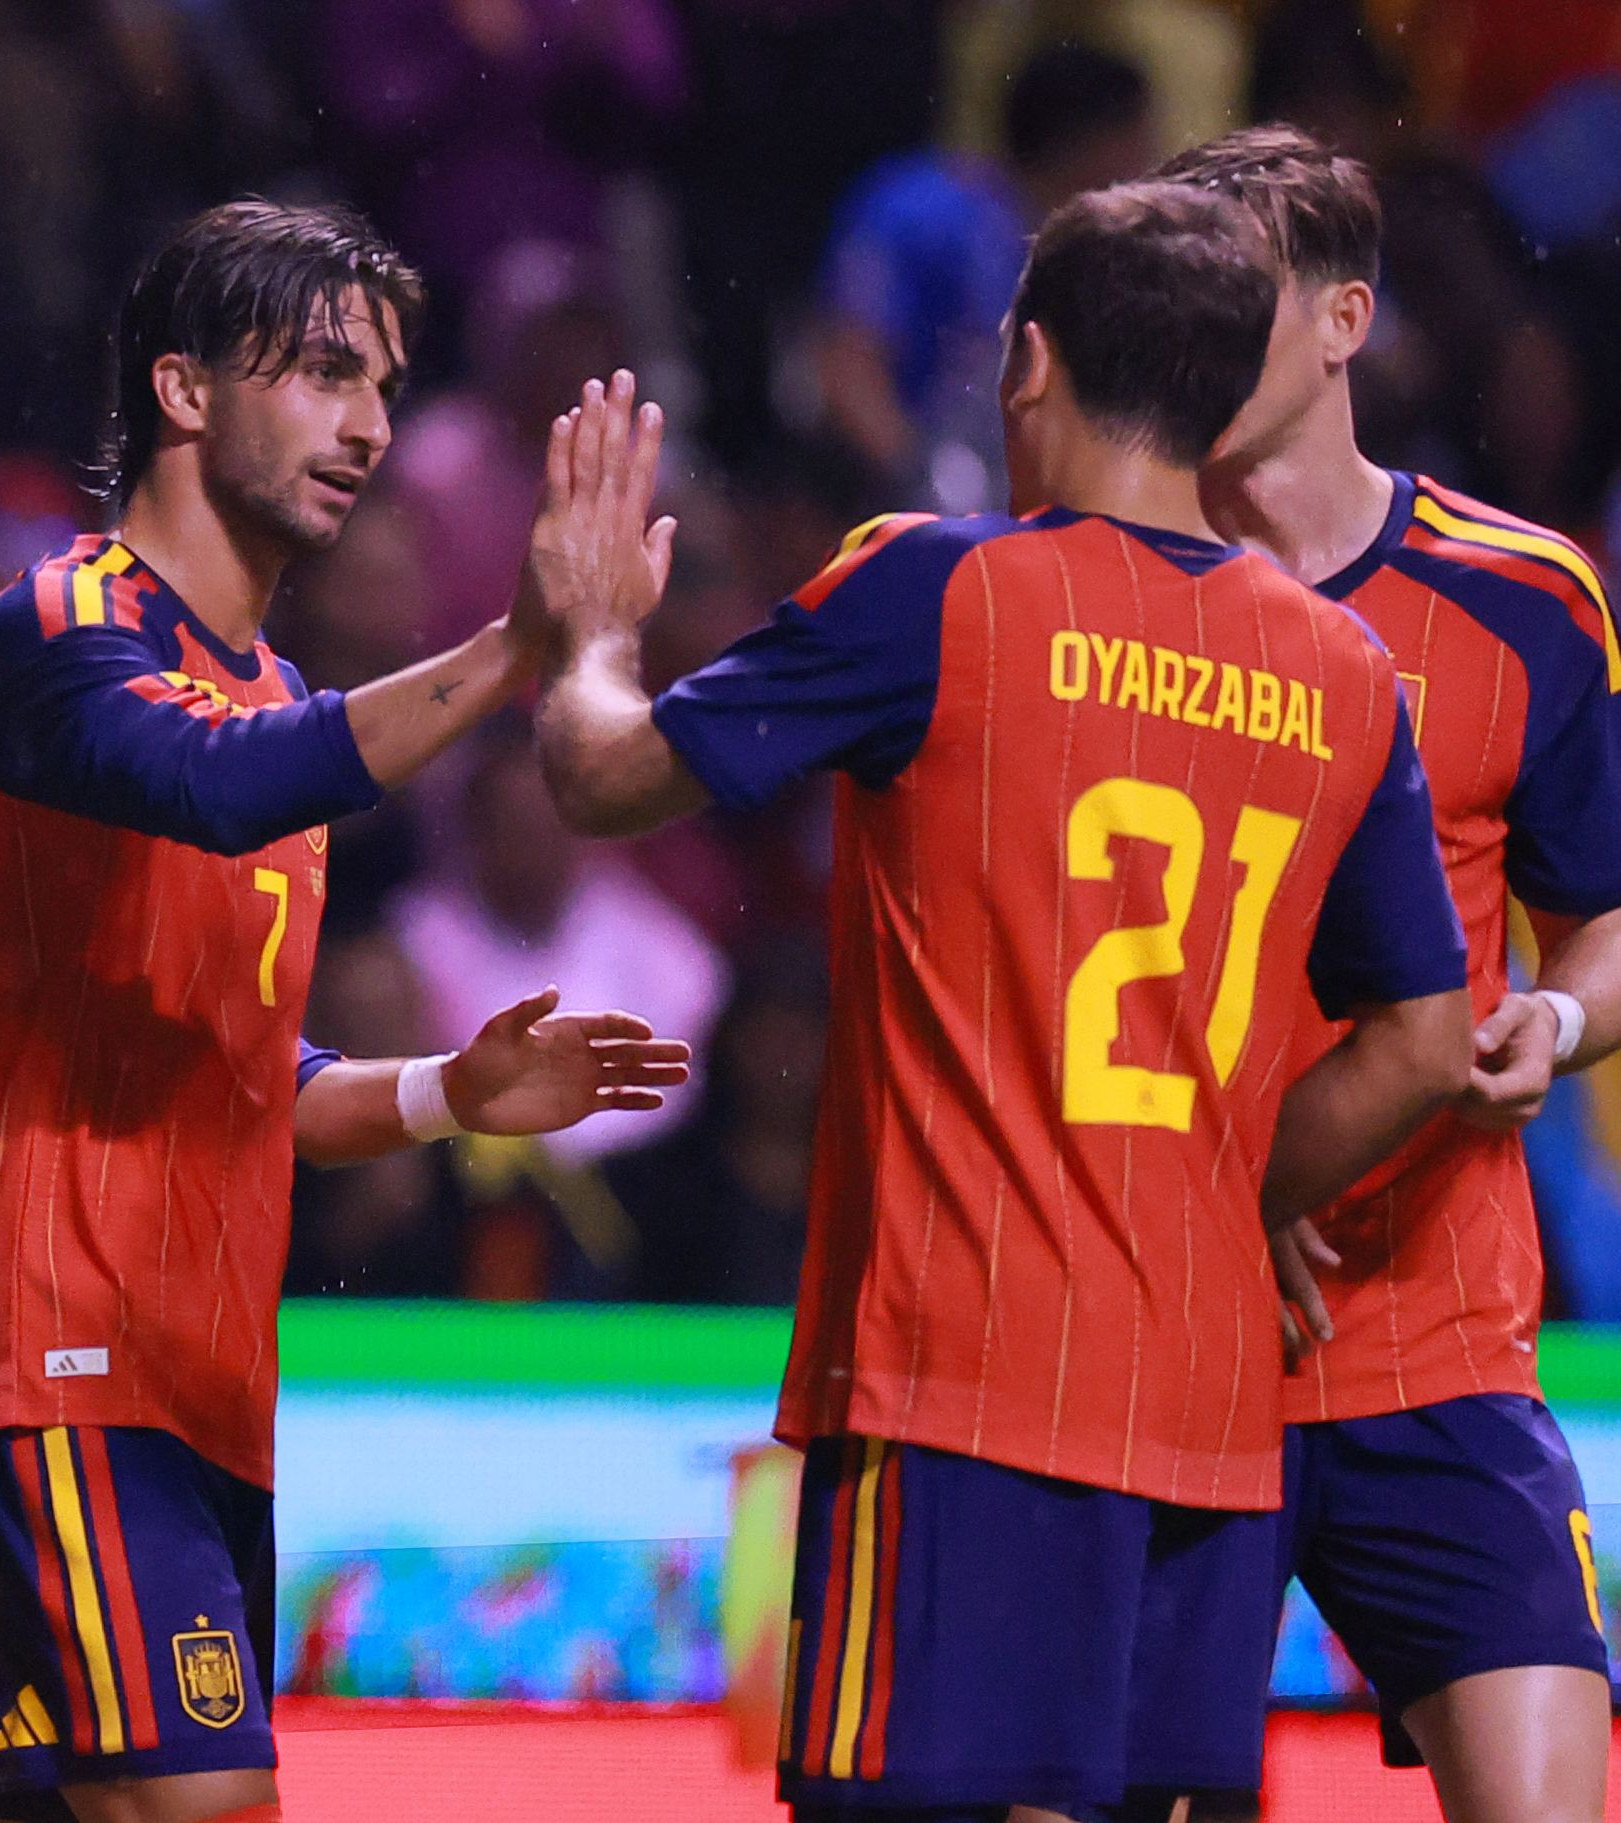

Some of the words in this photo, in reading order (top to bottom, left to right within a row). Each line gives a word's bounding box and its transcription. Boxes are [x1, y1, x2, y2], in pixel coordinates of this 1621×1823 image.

[1050, 629, 1334, 761] OYARZABAL
[254, 867, 288, 1007] 7
[1063, 777, 1302, 1133] 21
